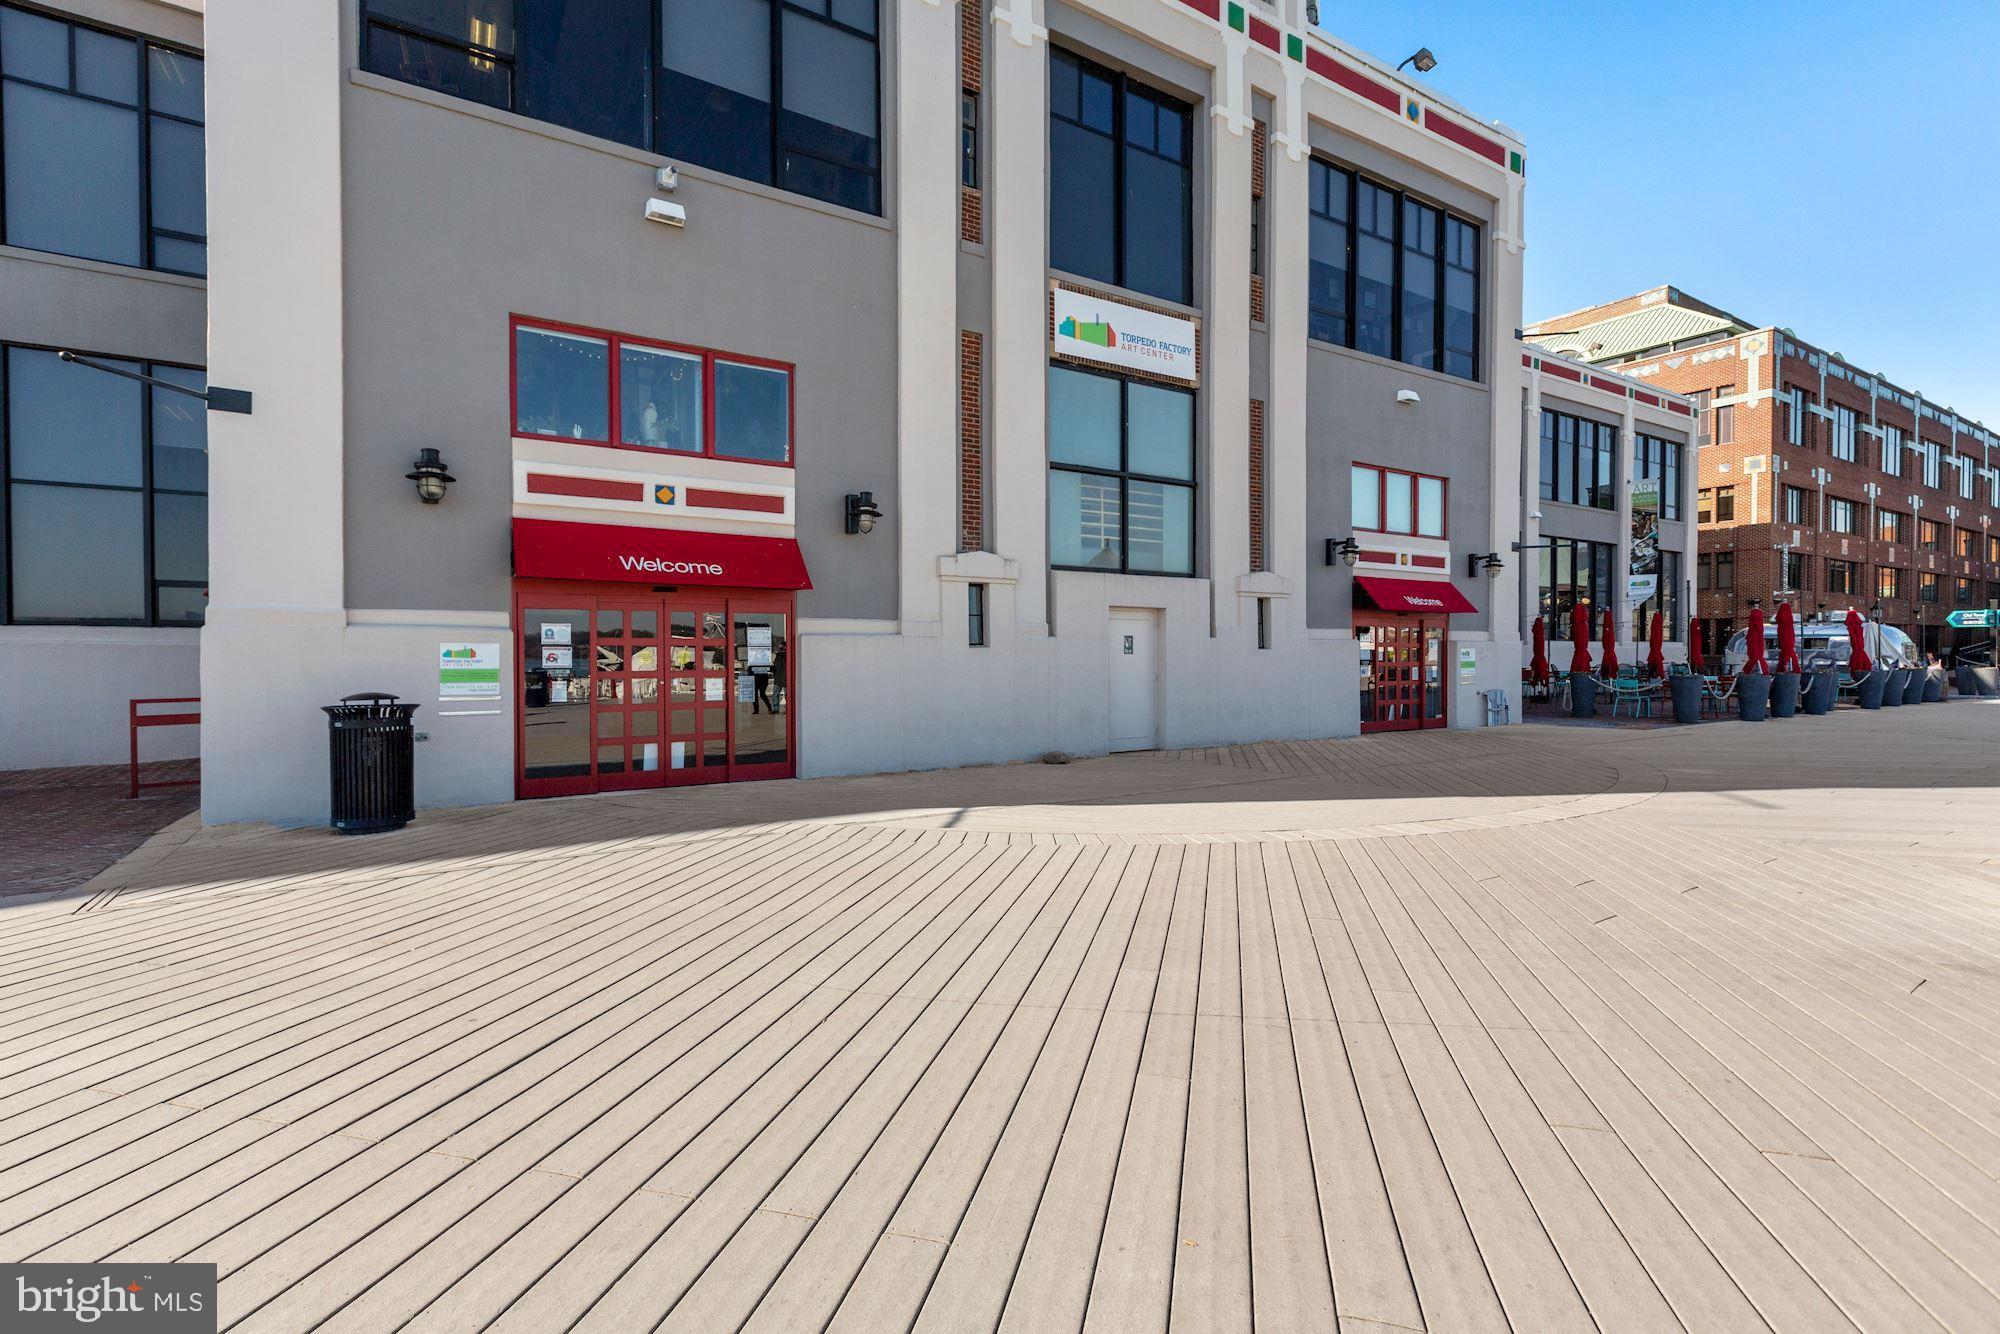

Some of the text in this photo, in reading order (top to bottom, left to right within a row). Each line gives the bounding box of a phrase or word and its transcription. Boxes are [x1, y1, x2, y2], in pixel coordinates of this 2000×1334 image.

[1121, 332, 1192, 356] TORPEDO FACTORY
[1121, 343, 1174, 361] ART CENTER
[1633, 483, 1656, 494] ART
[619, 555, 723, 575] Welcome
[1403, 595, 1444, 607] Welcome
